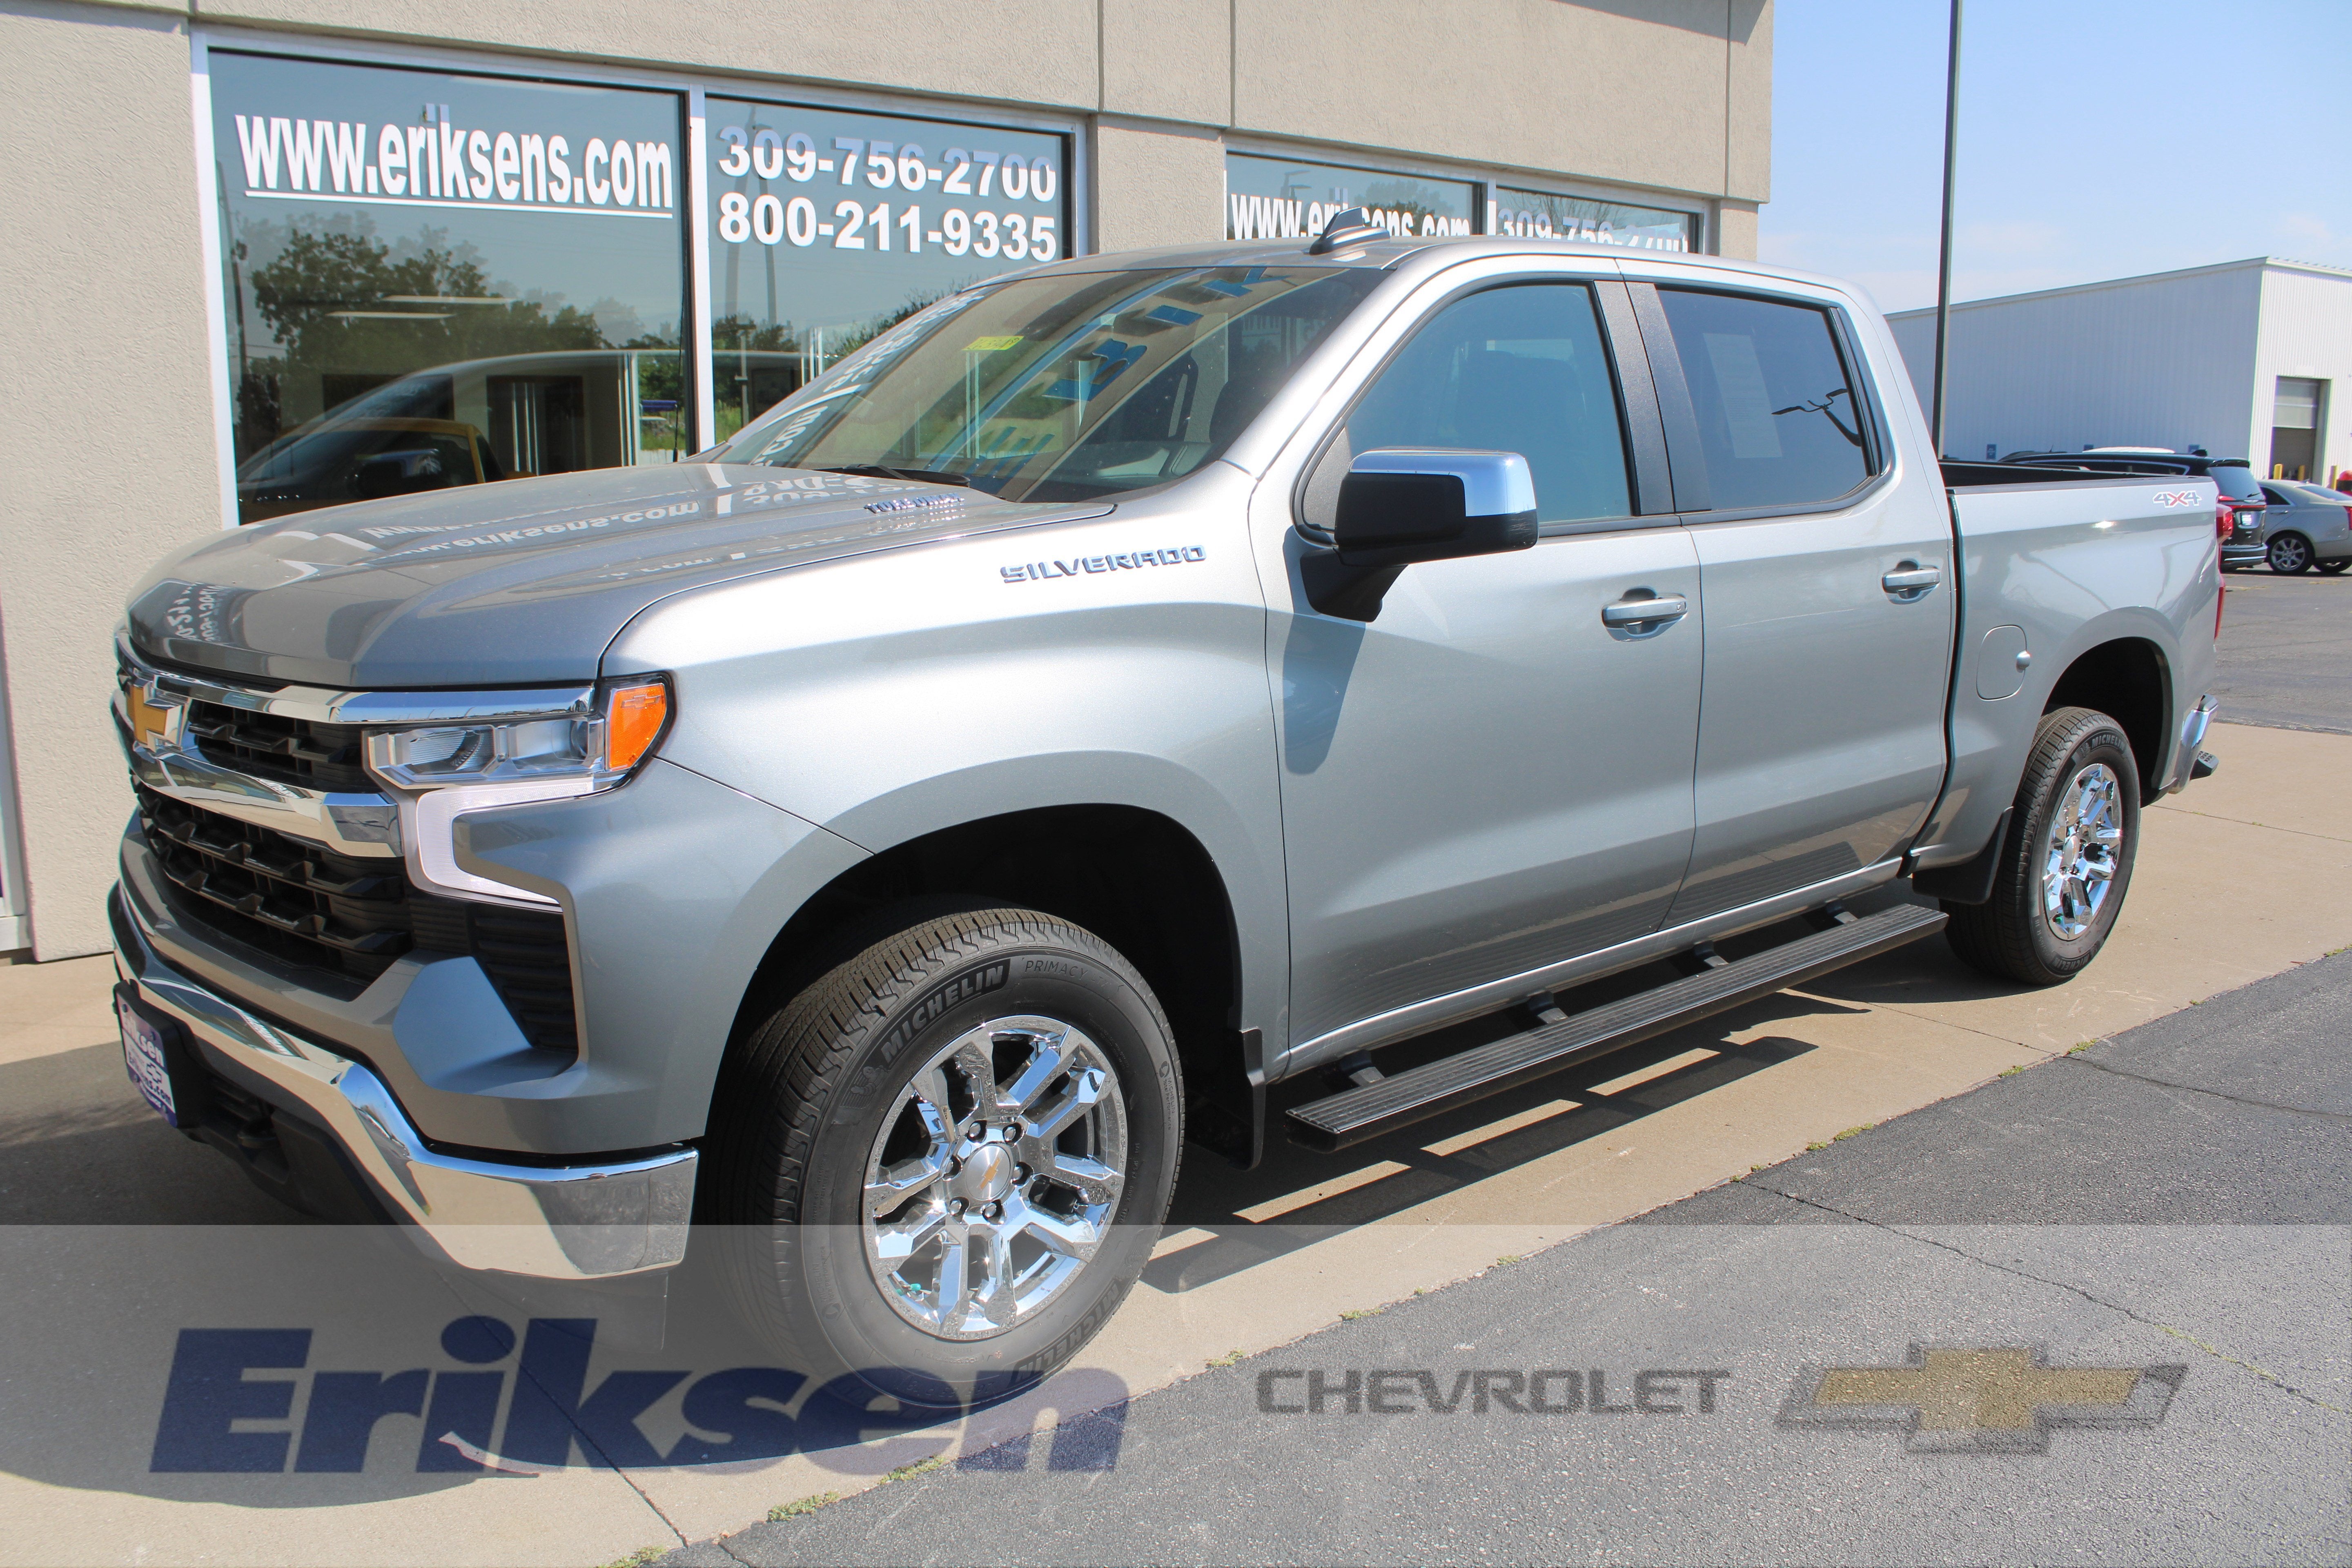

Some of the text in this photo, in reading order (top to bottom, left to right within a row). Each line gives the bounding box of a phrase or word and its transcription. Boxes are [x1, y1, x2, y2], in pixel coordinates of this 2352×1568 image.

[235, 103, 673, 207] www.eriksens.com
[719, 126, 1057, 202] 309-756-2700
[719, 192, 1057, 262] 800-211-9335
[1000, 545, 1207, 584] SILVERADO
[2092, 734, 2125, 751] MICHELIN
[1025, 960, 1088, 980] PRIMACY
[2052, 954, 2090, 971] MICHELIN
[881, 964, 1004, 1062] MICHELIN
[1167, 1077, 1176, 1114] MICHELIN
[1018, 1278, 1120, 1382] MICHELIN
